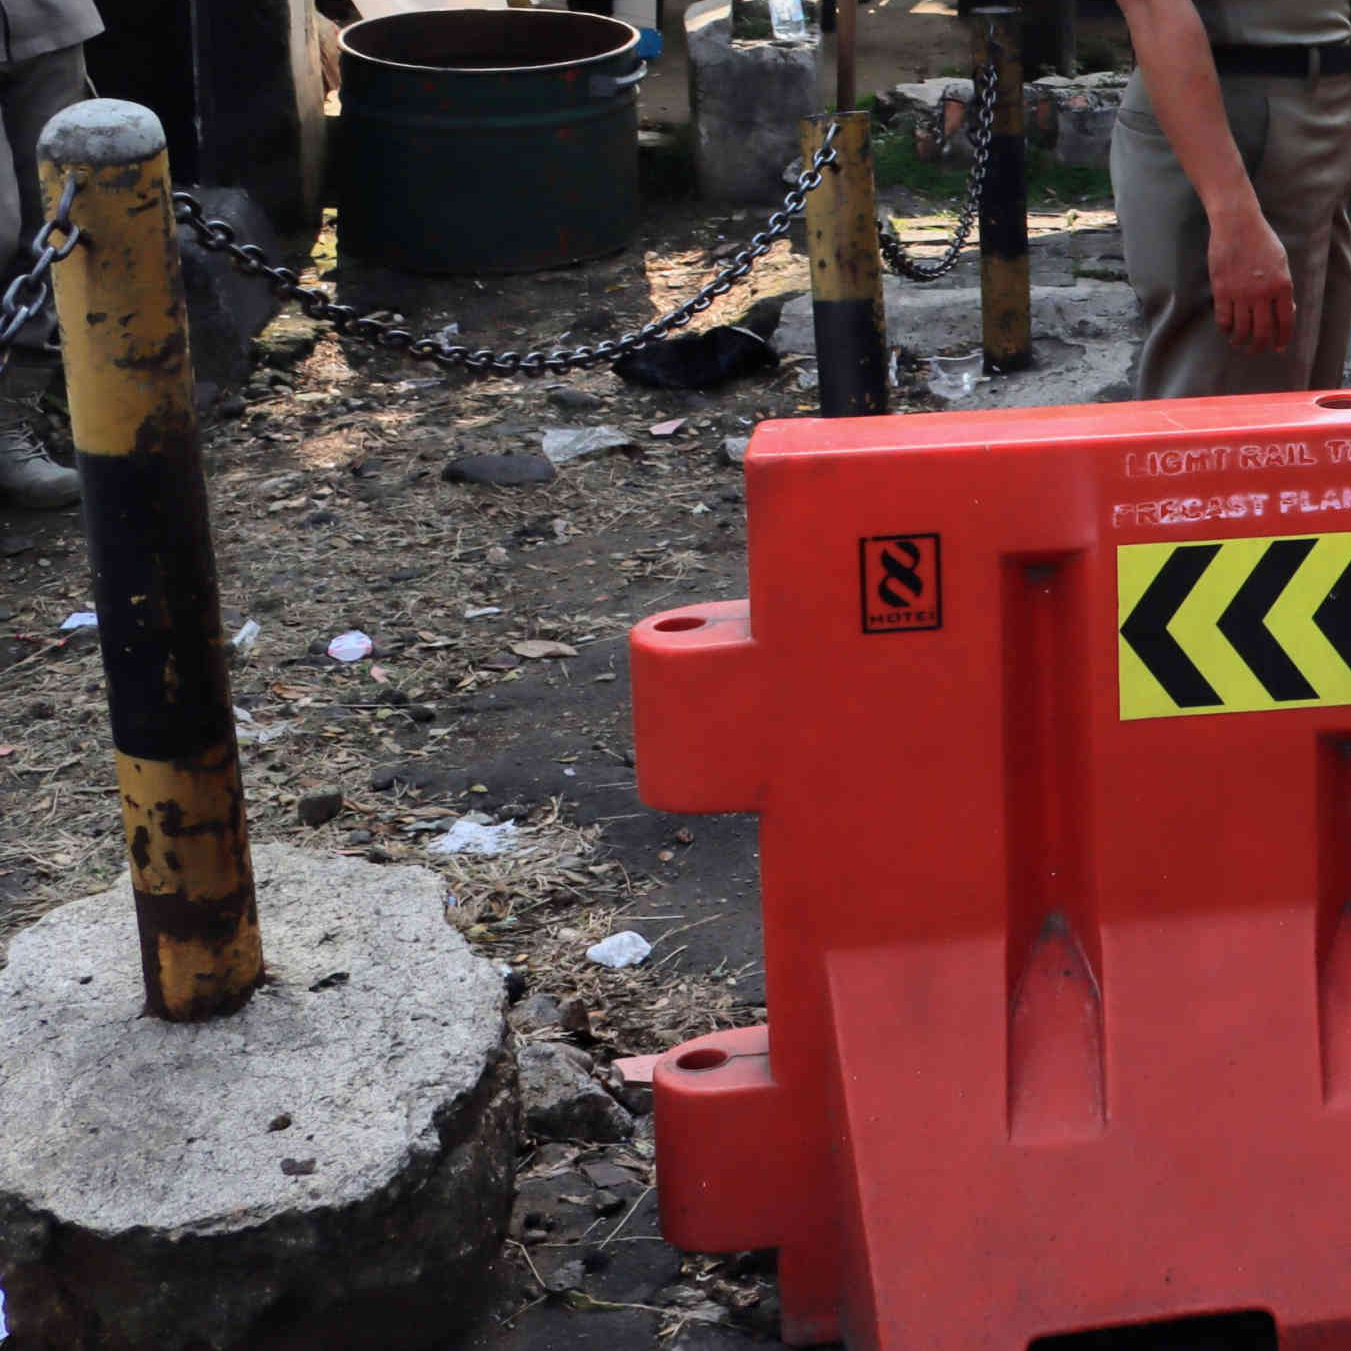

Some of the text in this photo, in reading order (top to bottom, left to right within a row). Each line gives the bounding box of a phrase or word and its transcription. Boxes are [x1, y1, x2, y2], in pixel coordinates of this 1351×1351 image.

[1126, 447, 1230, 478] LIGHT
[1239, 442, 1317, 470] RAIL
[1112, 493, 1269, 529] PRECAST
